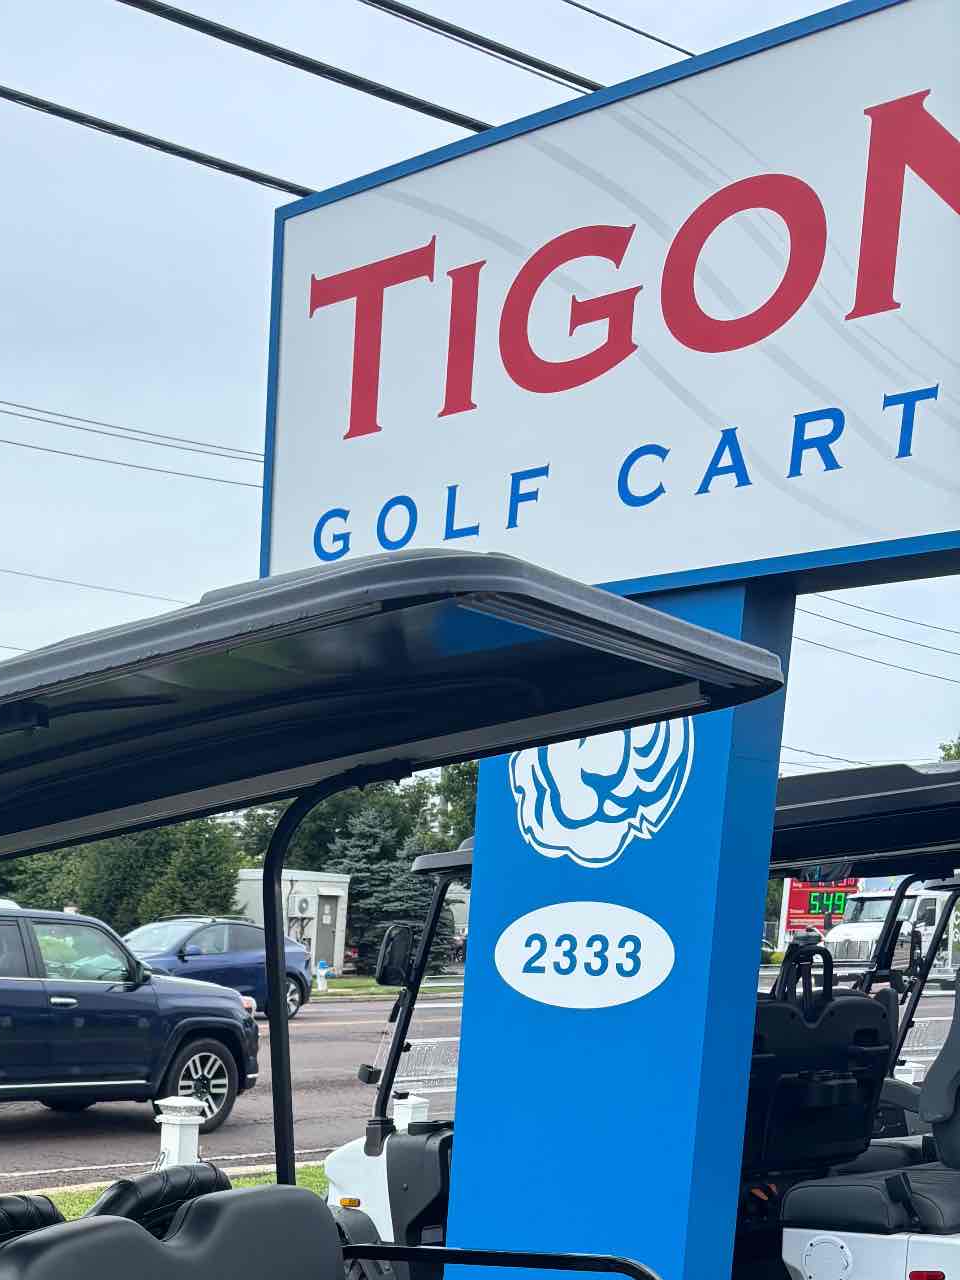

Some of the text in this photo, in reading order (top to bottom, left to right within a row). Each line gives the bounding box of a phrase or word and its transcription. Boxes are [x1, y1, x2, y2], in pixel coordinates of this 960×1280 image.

[308, 88, 960, 440] TIGON
[313, 384, 939, 562] GOLF CART
[522, 932, 642, 978] 2333
